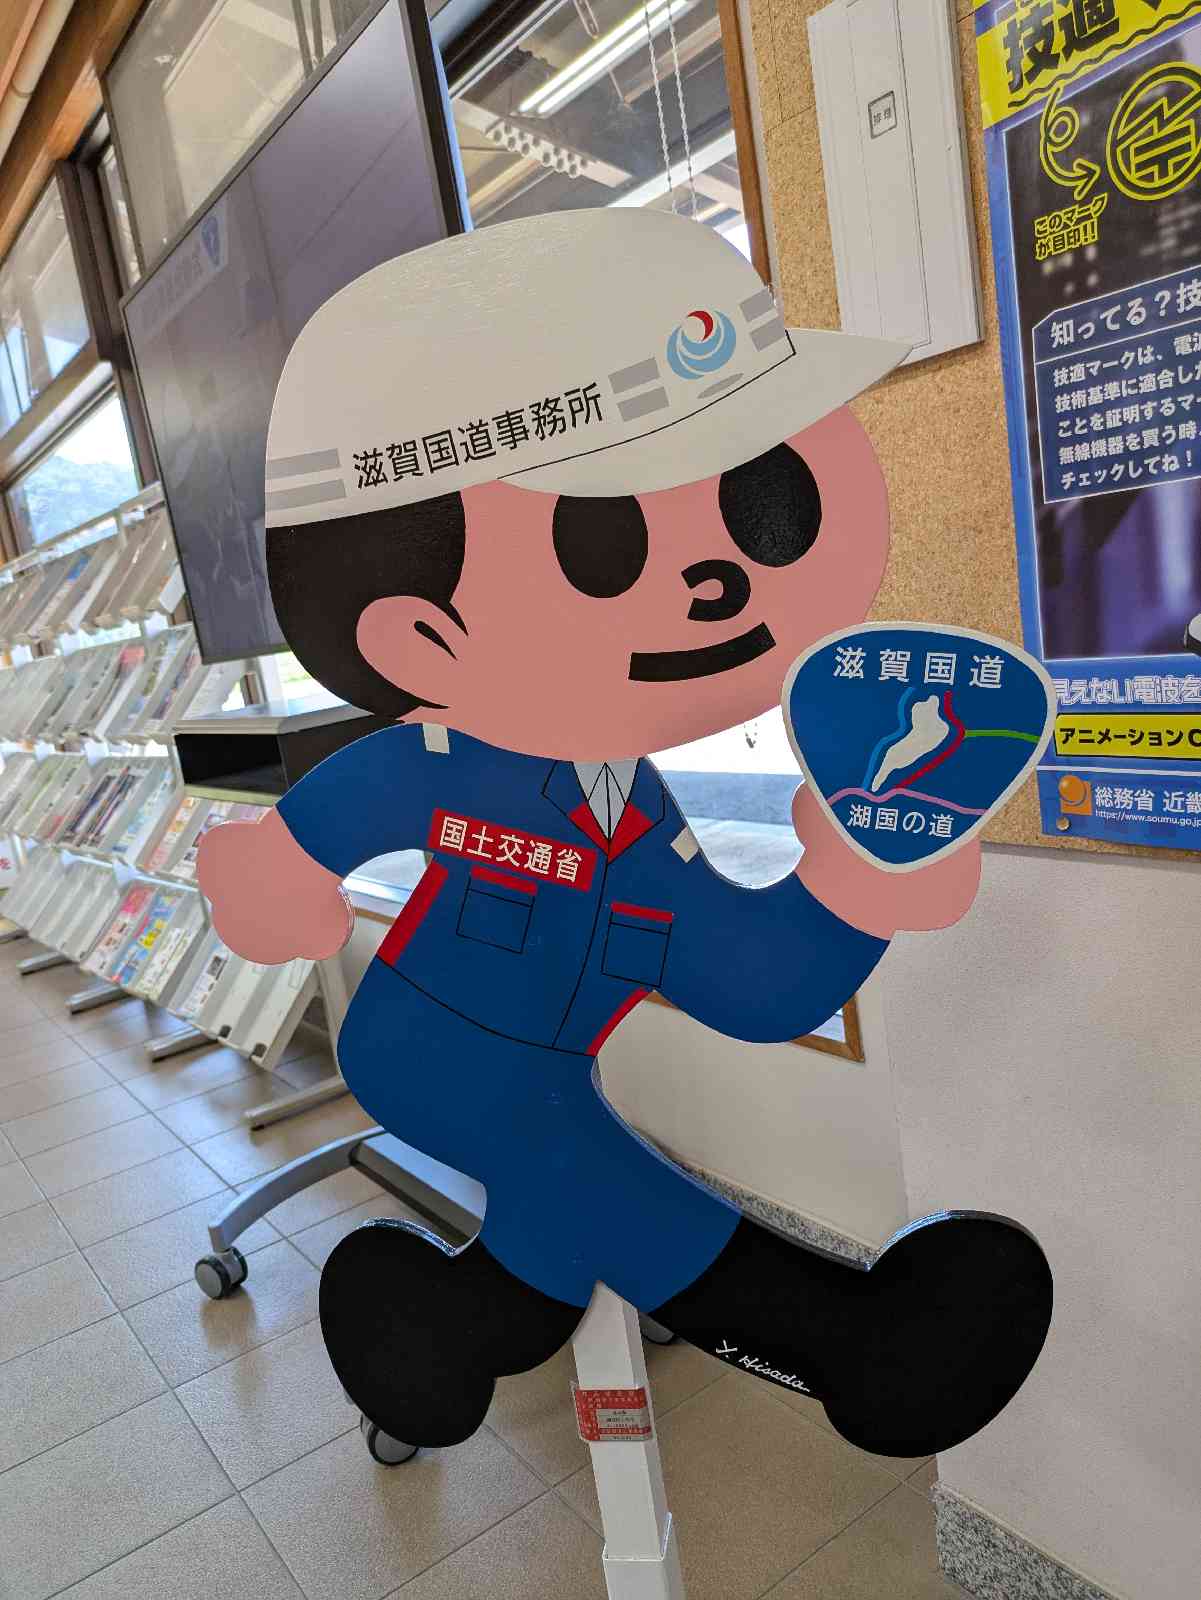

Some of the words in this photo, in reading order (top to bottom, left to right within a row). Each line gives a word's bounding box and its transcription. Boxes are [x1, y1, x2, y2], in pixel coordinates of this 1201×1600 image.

[1003, 0, 1161, 94] 技適
[1034, 192, 1108, 238] このマーク
[352, 382, 602, 489] 滋賀国道事務所
[1058, 394, 1201, 438] ことを証明するマ
[1059, 420, 1201, 465] 無線機器を買う時
[833, 646, 1004, 689] 滋賀国道
[847, 804, 954, 838] 湖国の道
[1095, 786, 1155, 812] 総務省
[439, 815, 582, 883] 国土交通省
